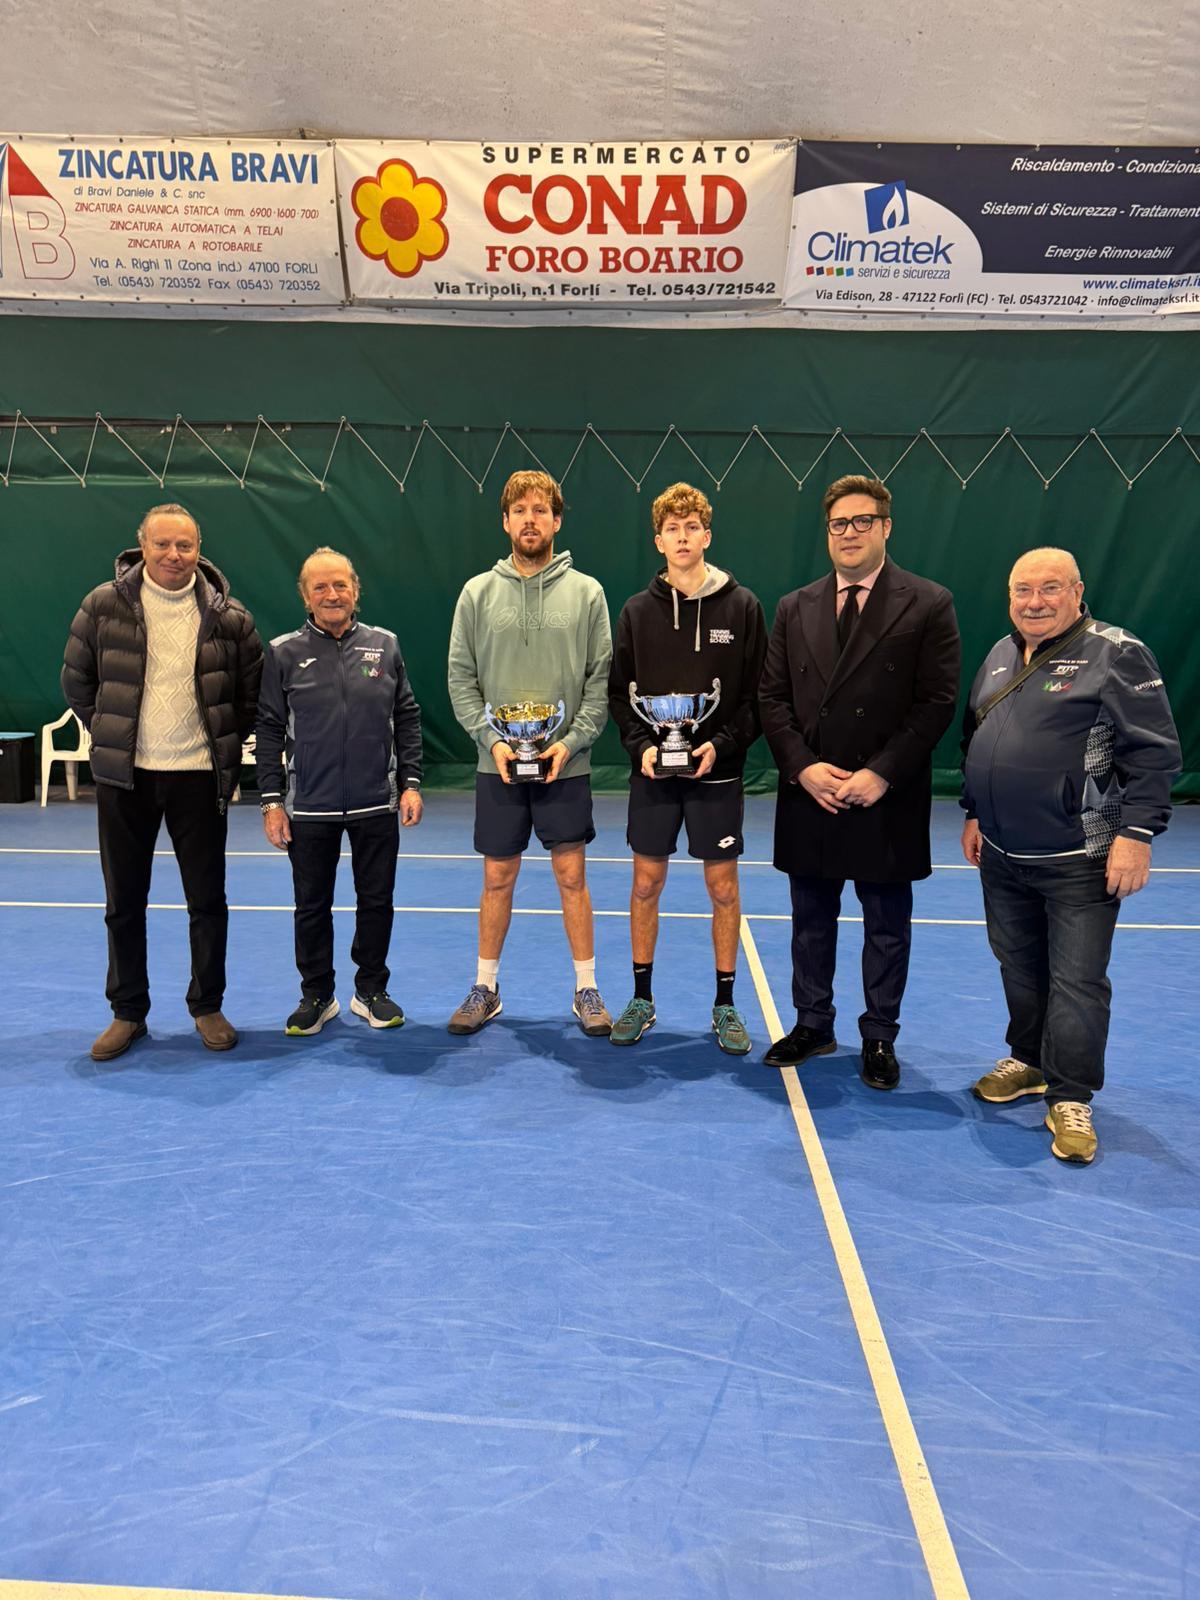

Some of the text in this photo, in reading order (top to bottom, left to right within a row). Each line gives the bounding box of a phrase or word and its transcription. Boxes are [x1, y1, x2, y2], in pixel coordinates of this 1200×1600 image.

[482, 146, 750, 163] SUPERMERCATO
[59, 149, 319, 184] ZINCATURA BRAVI
[1011, 158, 1115, 173] Riscaldamento
[74, 186, 205, 199] di Bravi Daniele & C. snc
[75, 203, 123, 213] ZINCATURA
[128, 204, 179, 214] GALVANICA
[184, 205, 219, 215] STATICA
[484, 174, 747, 235] CONAD
[981, 203, 1032, 215] Sistemi
[1036, 204, 1047, 215] di
[1050, 203, 1118, 216] Sicurezza
[110, 221, 283, 235] ZINCATURA AUTOMATICA A TELAI
[128, 239, 263, 252] ZINCATURA A ROTOBARILE
[808, 231, 954, 264] Climatek
[1045, 245, 1173, 260] Energie Rinnovabili
[90, 258, 109, 269] Via
[115, 259, 126, 269] A.
[132, 259, 159, 271] Righi
[178, 259, 211, 272] (Zona
[217, 261, 242, 273] ind.)
[249, 262, 279, 273] 47100
[486, 246, 744, 274] FORO BOARIO
[858, 266, 950, 279] servizi e sicurezza
[94, 276, 320, 291] Tel. (0543) 720352 Fax (0543) 720352
[435, 283, 461, 294] Via
[465, 283, 527, 297] Tripoli,
[532, 283, 555, 295] n.1
[627, 284, 656, 296] Tel.
[662, 283, 776, 296] 0543/721542
[815, 290, 833, 300] Via
[836, 290, 875, 302] Edison,
[879, 291, 892, 301] 28
[902, 292, 936, 302] 47122
[966, 292, 989, 305] (FC)
[999, 294, 1016, 304] Tel.
[1019, 295, 1087, 305] 0543721042
[1097, 293, 1199, 307] info@climateksrl.it
